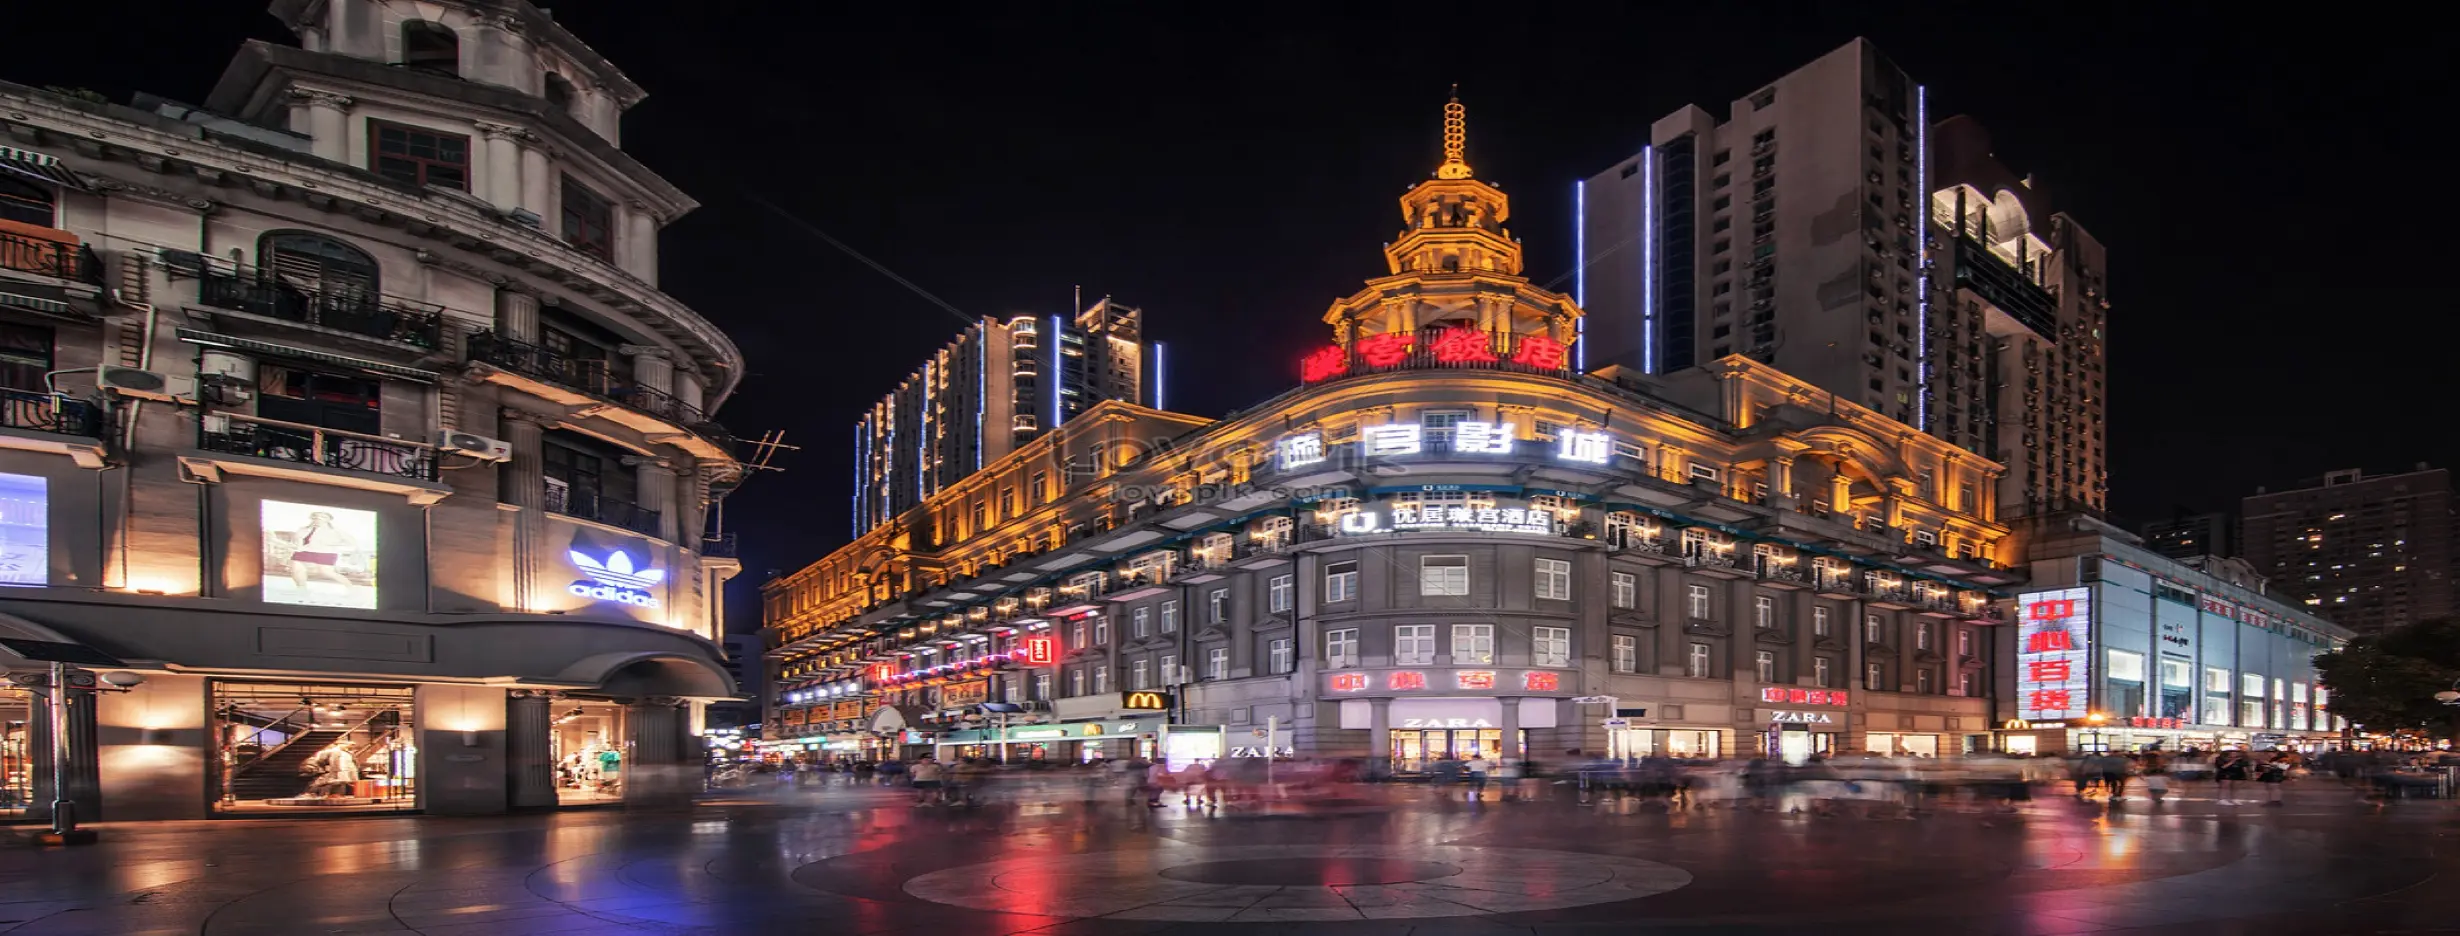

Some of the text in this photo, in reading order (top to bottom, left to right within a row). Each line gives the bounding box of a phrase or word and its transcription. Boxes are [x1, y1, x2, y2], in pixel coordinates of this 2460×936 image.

[568, 584, 659, 608] adidas
[2027, 599, 2074, 711] 中心百货
[1403, 718, 1492, 728] ZARA
[1772, 711, 1832, 723] ZARA
